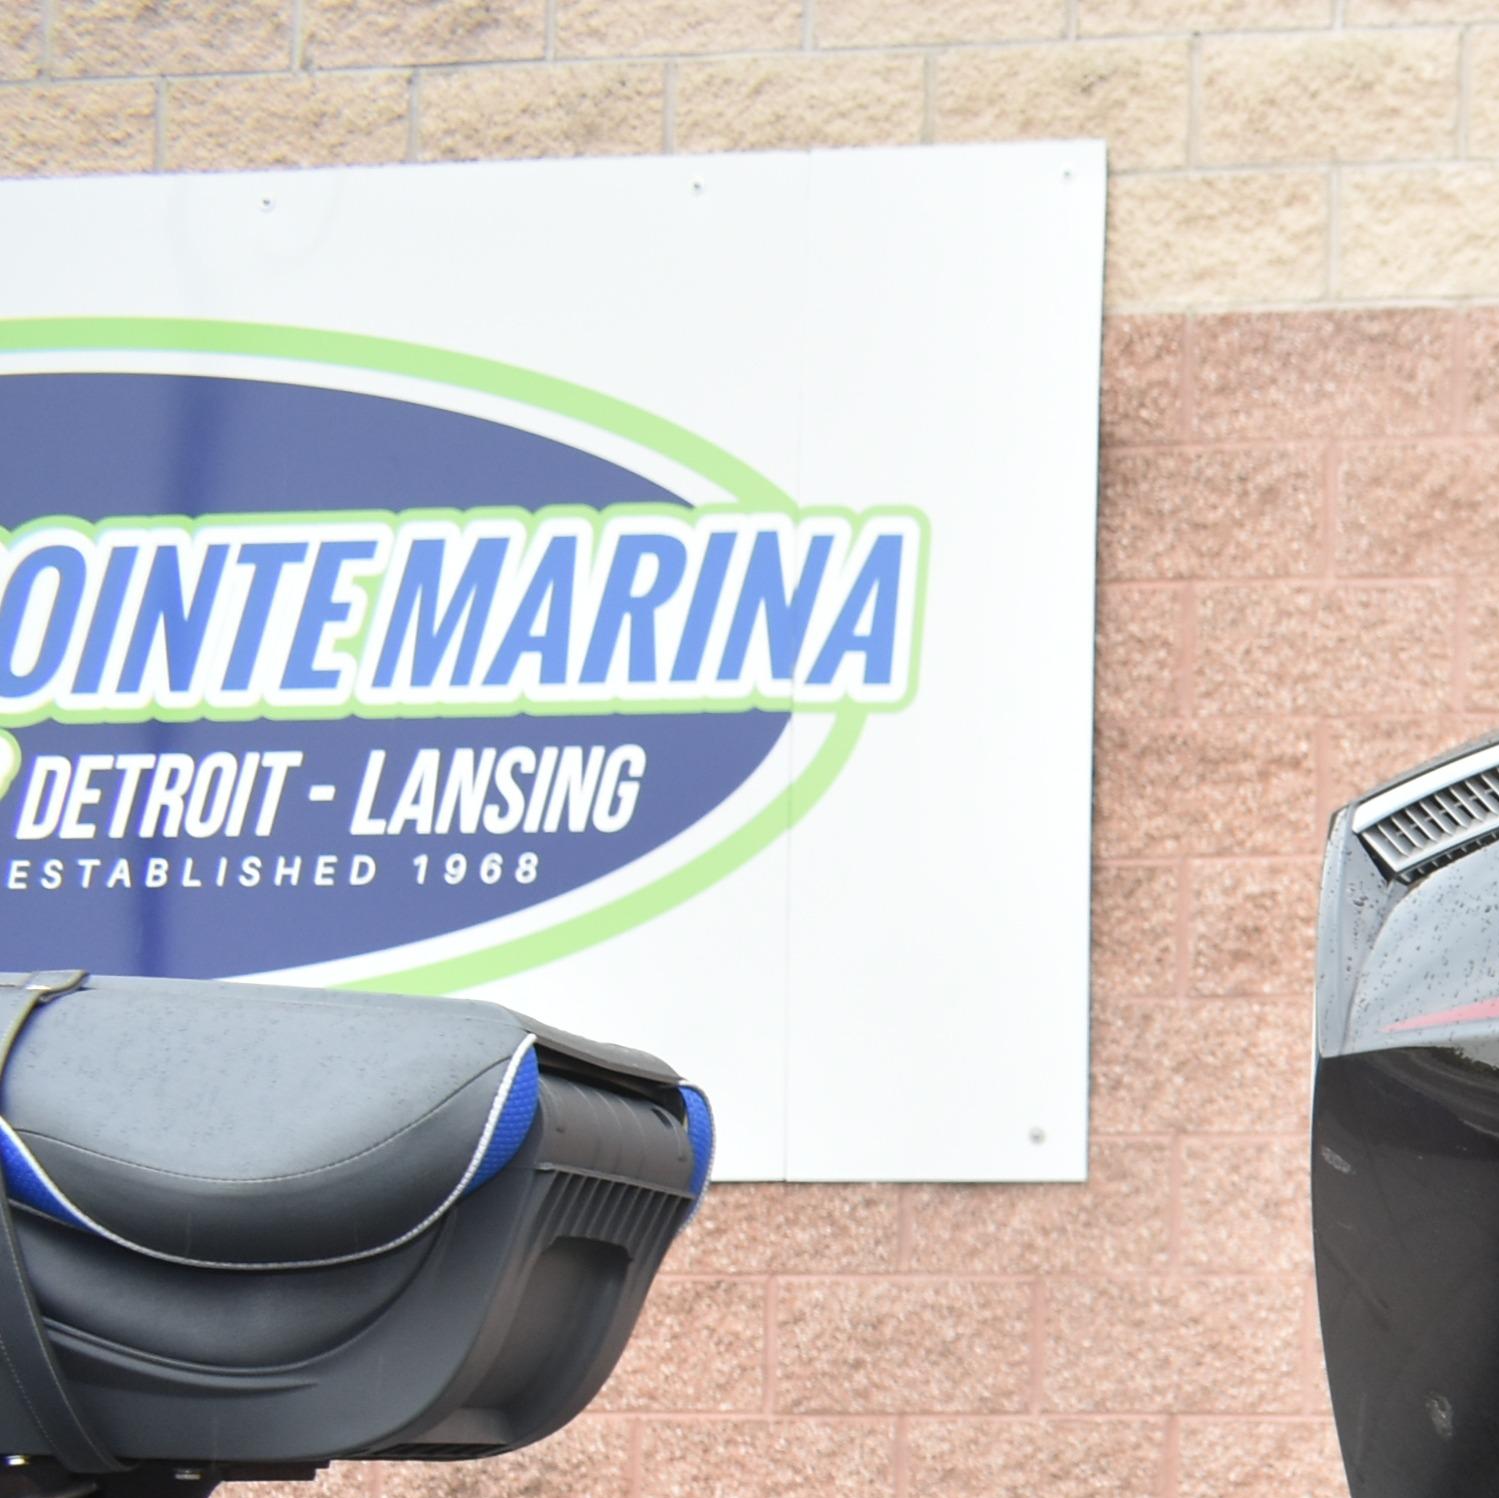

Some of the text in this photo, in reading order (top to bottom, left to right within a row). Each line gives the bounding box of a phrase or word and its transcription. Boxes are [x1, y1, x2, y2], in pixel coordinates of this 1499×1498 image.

[371, 530, 904, 688] MARINA
[15, 751, 304, 840] DETROIT
[350, 744, 647, 835] LANSING
[7, 852, 540, 890] ESTABLISHED 1968
